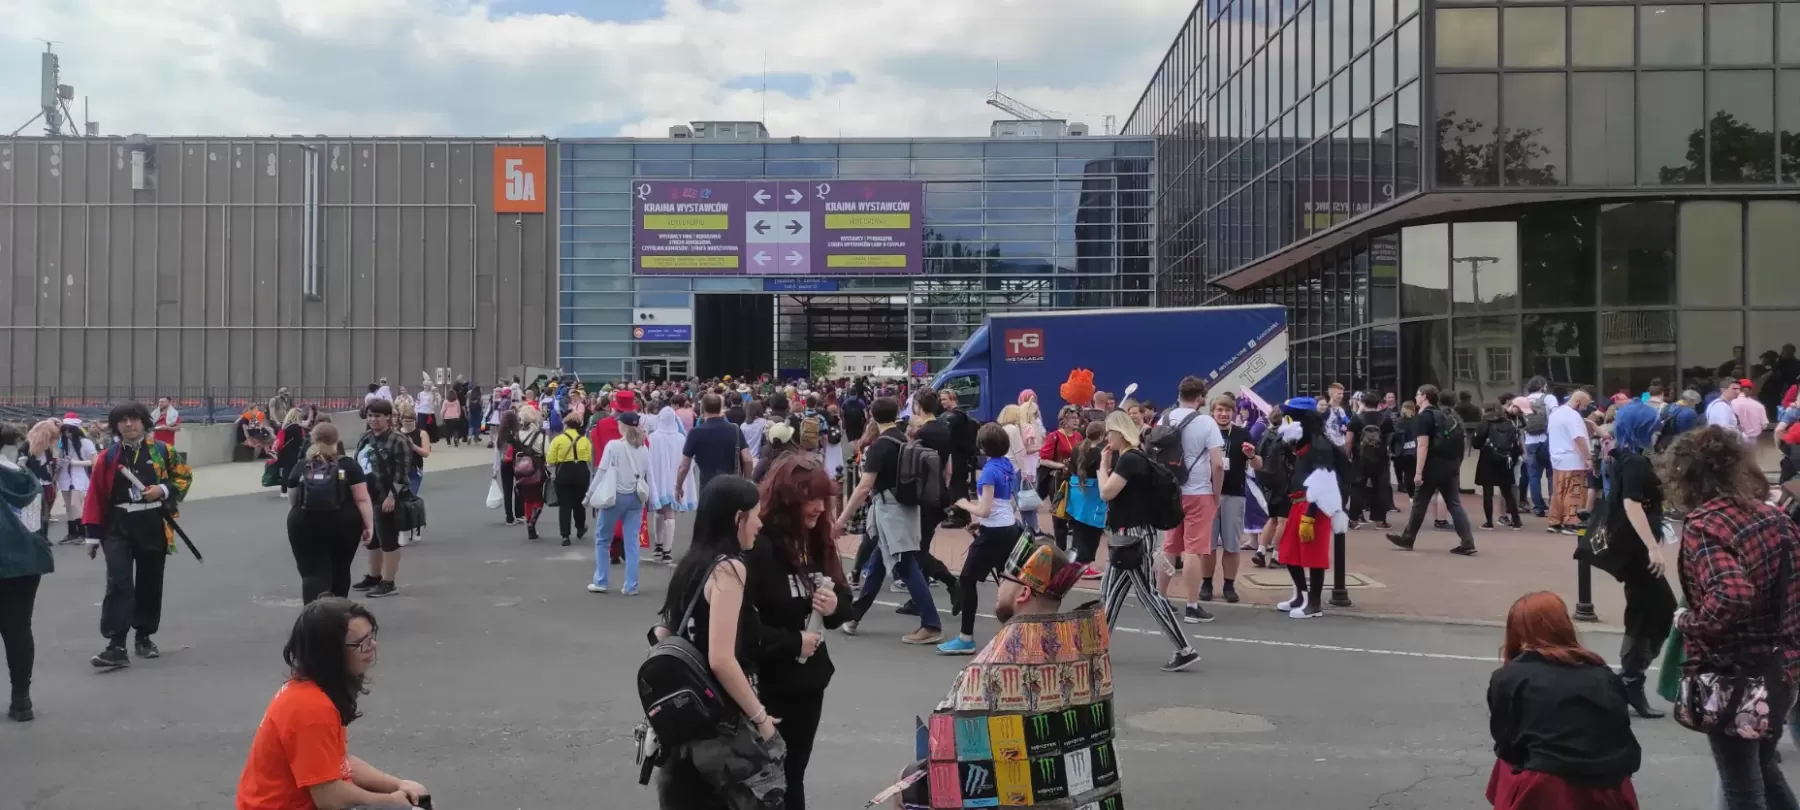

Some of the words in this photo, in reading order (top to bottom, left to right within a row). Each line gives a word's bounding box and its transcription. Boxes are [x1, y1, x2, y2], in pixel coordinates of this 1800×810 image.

[505, 158, 536, 201] 5A
[644, 203, 675, 213] KRAINA
[676, 201, 729, 213] WYSTAWCÓW
[825, 202, 857, 212] KRAINA
[858, 200, 910, 212] WYSTAWCÓW
[1009, 333, 1040, 354] TG
[1239, 353, 1267, 384] TG
